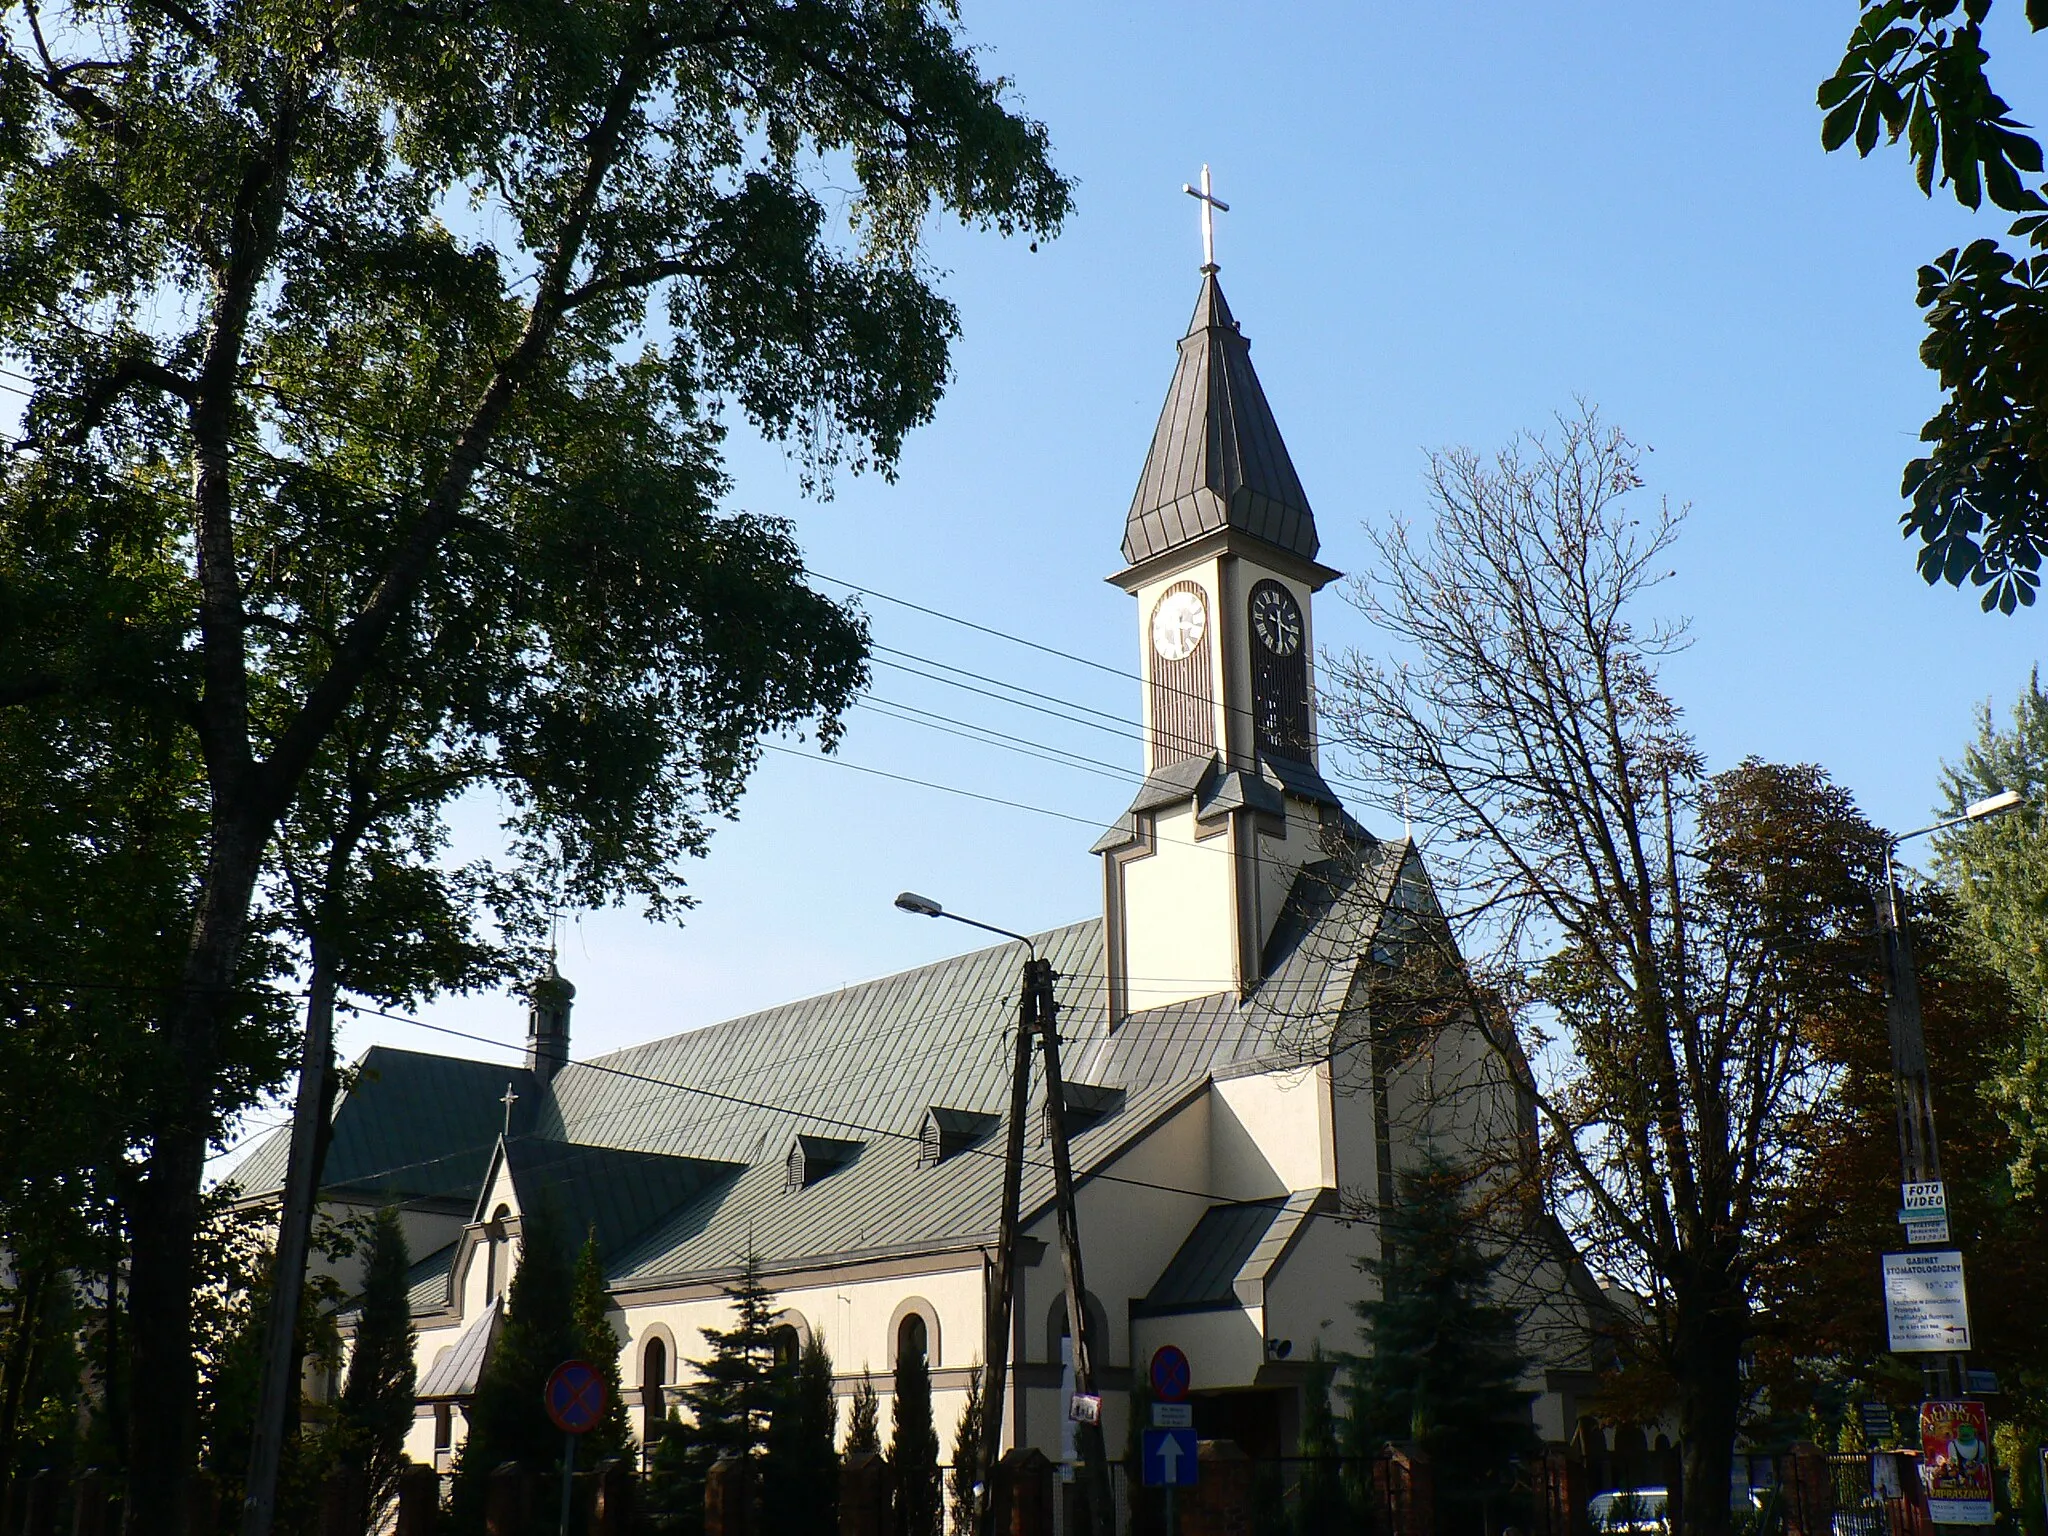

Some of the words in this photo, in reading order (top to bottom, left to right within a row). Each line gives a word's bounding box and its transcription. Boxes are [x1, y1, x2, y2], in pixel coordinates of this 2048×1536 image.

[1909, 1184, 1938, 1196] FOTO
[1907, 1196, 1943, 1207] VIDEO
[1886, 1264, 1961, 1275] STOMATOLOGICZNY
[1932, 1403, 1968, 1413] CYRK
[1920, 1411, 1981, 1424] ARLEKIN
[1929, 1489, 1988, 1500] ZAPRASZAMY
